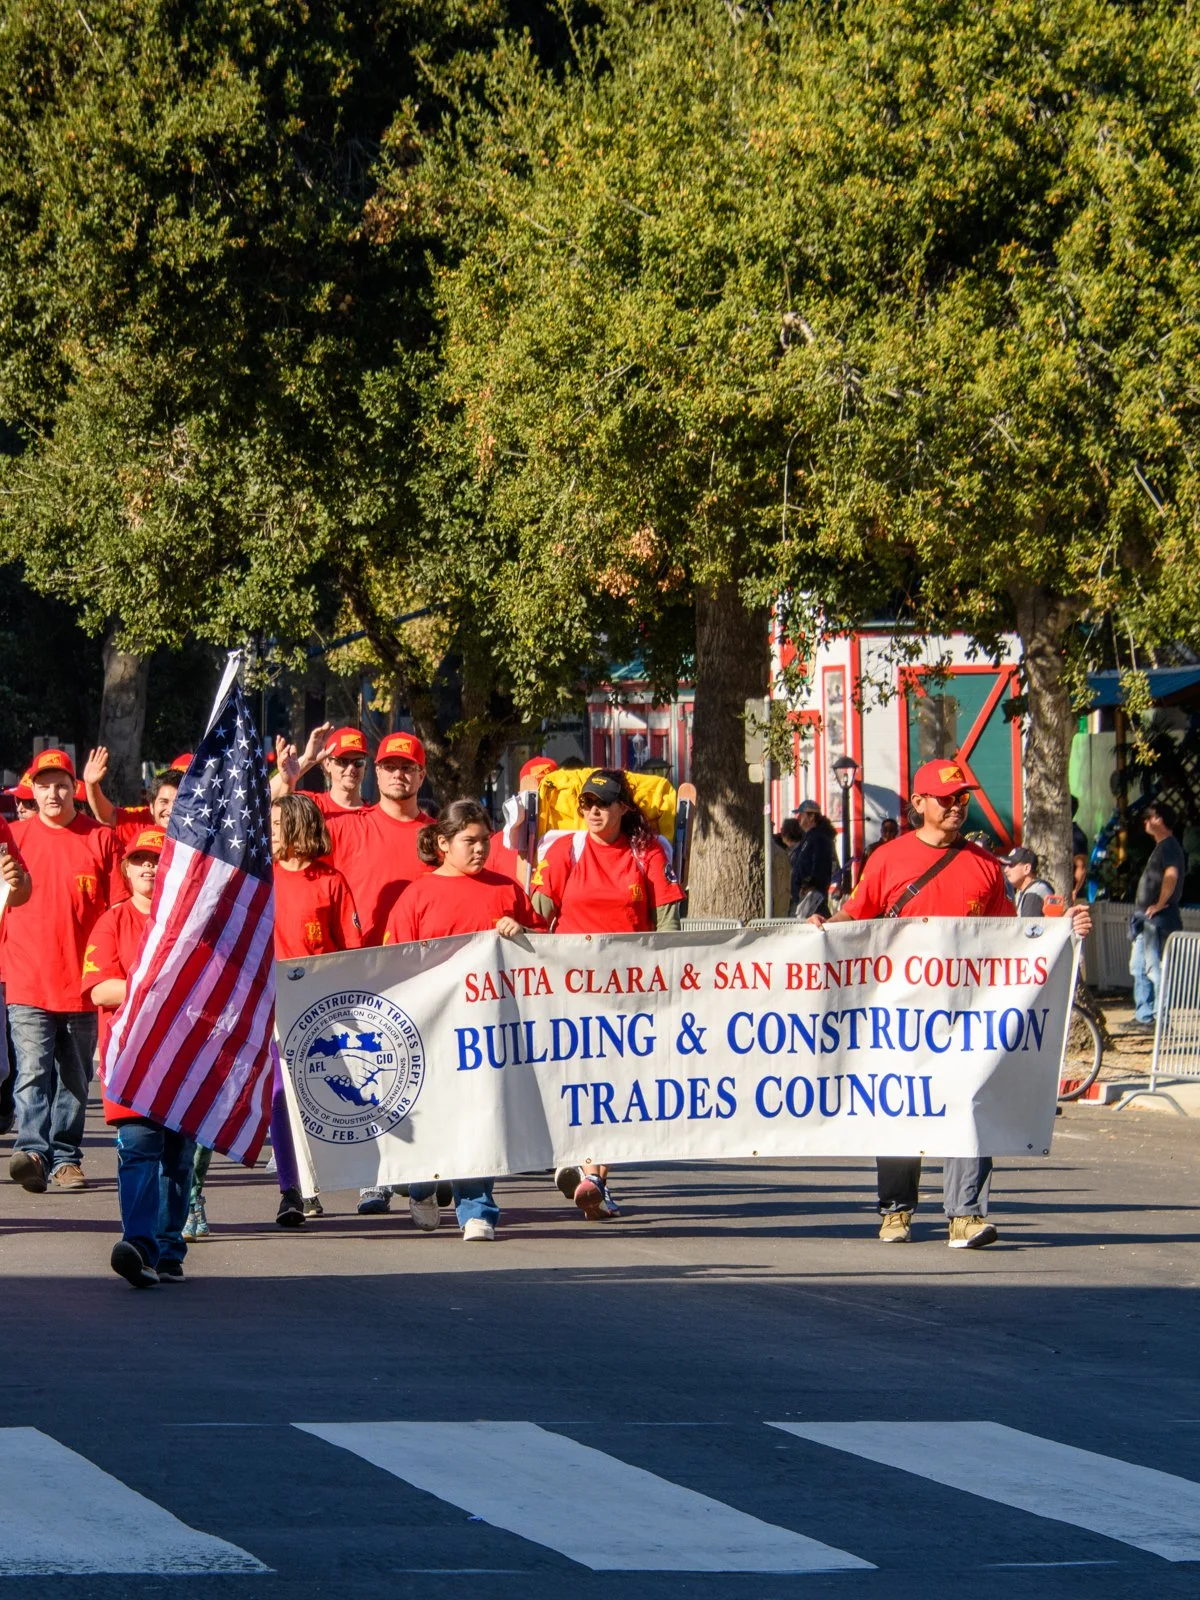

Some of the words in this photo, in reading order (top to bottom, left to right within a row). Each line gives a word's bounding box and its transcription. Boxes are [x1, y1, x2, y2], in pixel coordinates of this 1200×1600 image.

[465, 966, 554, 1003] SANTA
[565, 965, 668, 994] CLARA
[680, 963, 701, 990] &
[714, 961, 772, 990] SAN
[785, 955, 893, 991] BENITO
[905, 956, 1048, 987] COUNTIES
[298, 1026, 320, 1063] AMERICAN
[320, 1010, 364, 1027] FEDERATION
[367, 1013, 377, 1021] OF
[379, 1019, 400, 1041] LABOR
[298, 994, 383, 1030] CONSTRUCTION
[386, 1006, 419, 1049] TRADES
[407, 1055, 421, 1089] DEPT.
[376, 1053, 393, 1065] CIO
[454, 1012, 657, 1071] BUILDING
[676, 1011, 707, 1055] &
[726, 1007, 1050, 1054] CONSTRUCTION
[297, 1077, 320, 1115] CONGRESS
[320, 1113, 331, 1121] OF
[332, 1112, 376, 1125] INDUSTRIAL
[377, 1057, 407, 1113] ORGANIZATIONS
[309, 1061, 326, 1073] AFL
[332, 1130, 360, 1141] FEB.
[386, 1097, 411, 1125] 1908
[560, 1076, 737, 1127] TRADES
[755, 1073, 946, 1119] COUNCIL
